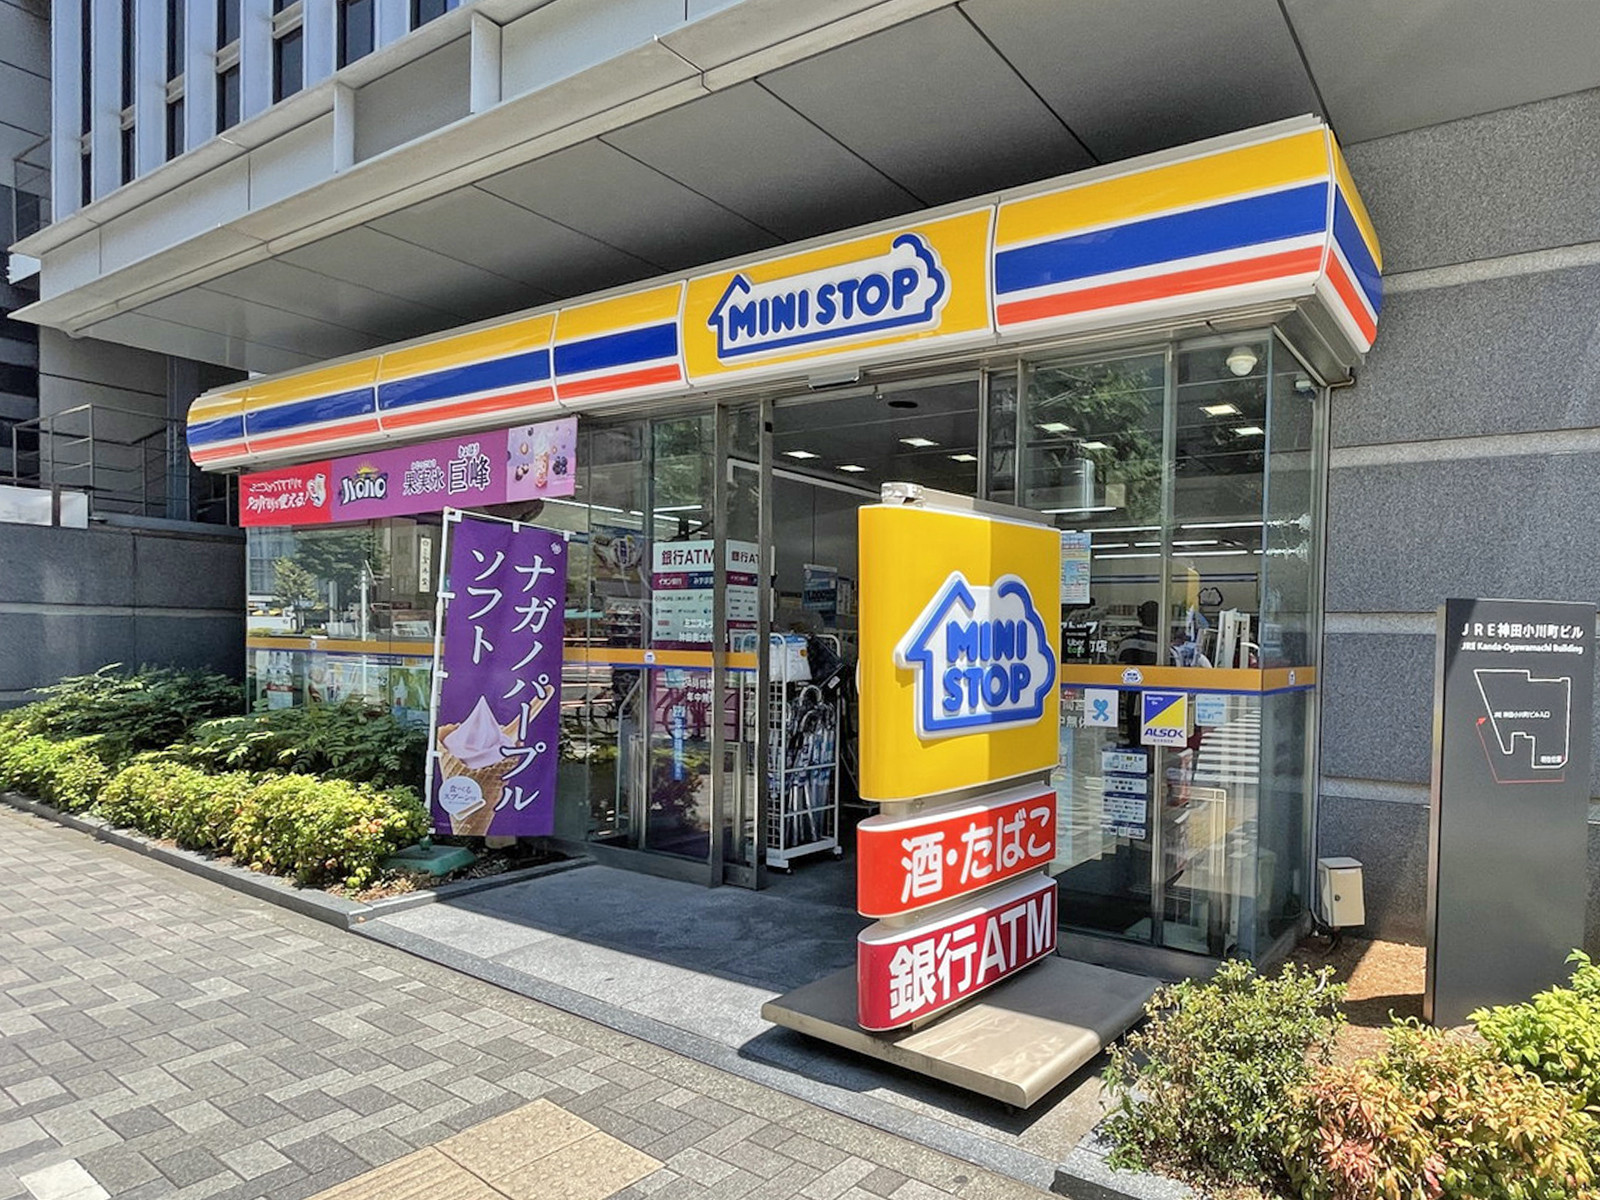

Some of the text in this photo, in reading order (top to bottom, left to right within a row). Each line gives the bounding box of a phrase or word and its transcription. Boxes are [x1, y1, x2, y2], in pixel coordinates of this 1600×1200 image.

[729, 267, 919, 341] MINI STOP
[448, 454, 490, 495] 巨峰
[661, 549, 714, 565] 銀行ATM
[467, 549, 504, 665] ソフト
[946, 620, 1028, 662] MINI
[1067, 637, 1085, 647] Uber
[1461, 642, 1476, 651] JRE
[1553, 643, 1584, 655] Building
[495, 554, 555, 812] ナガノパープル
[943, 662, 1031, 712] STOP
[1144, 728, 1184, 738] ALSOK
[901, 806, 1051, 904] 酒・たばこ
[889, 891, 1052, 1020] 銀行ATM
